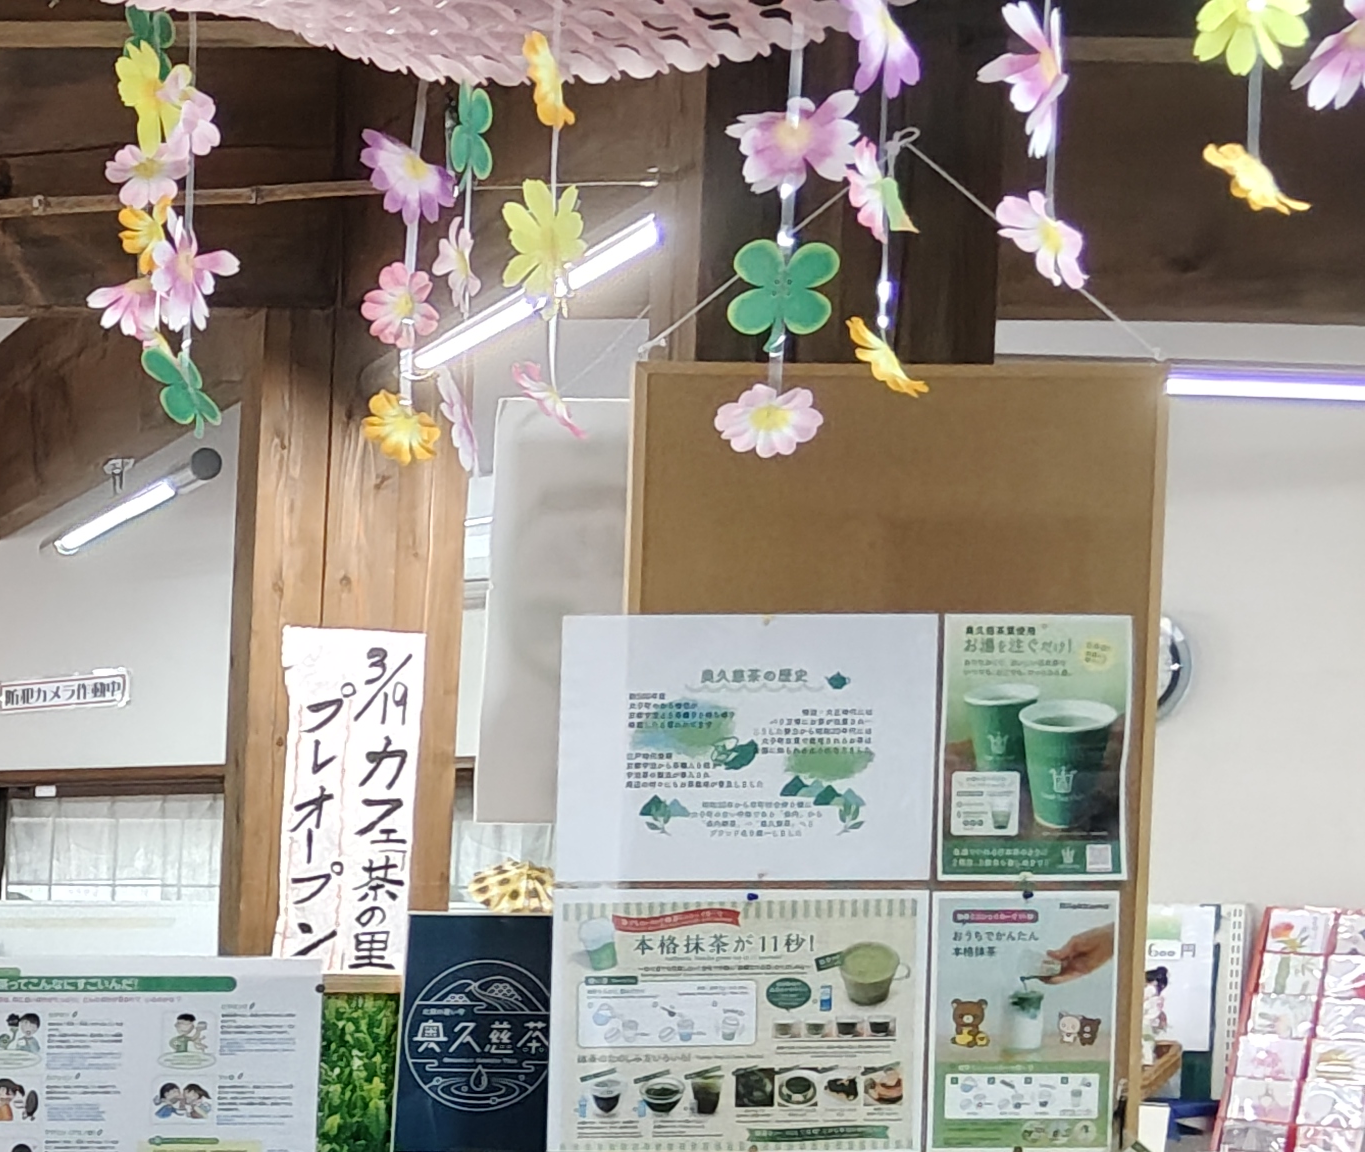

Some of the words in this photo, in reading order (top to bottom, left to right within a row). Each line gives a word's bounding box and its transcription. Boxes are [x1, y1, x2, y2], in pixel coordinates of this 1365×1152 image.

[5, 680, 122, 706] 防犯カメラ作動中
[289, 682, 357, 957] プレオープン
[633, 934, 816, 956] 本格抹茶が11秒!
[952, 930, 1040, 942] おうちでかんたん
[412, 1019, 549, 1055] 奥久慈茶
